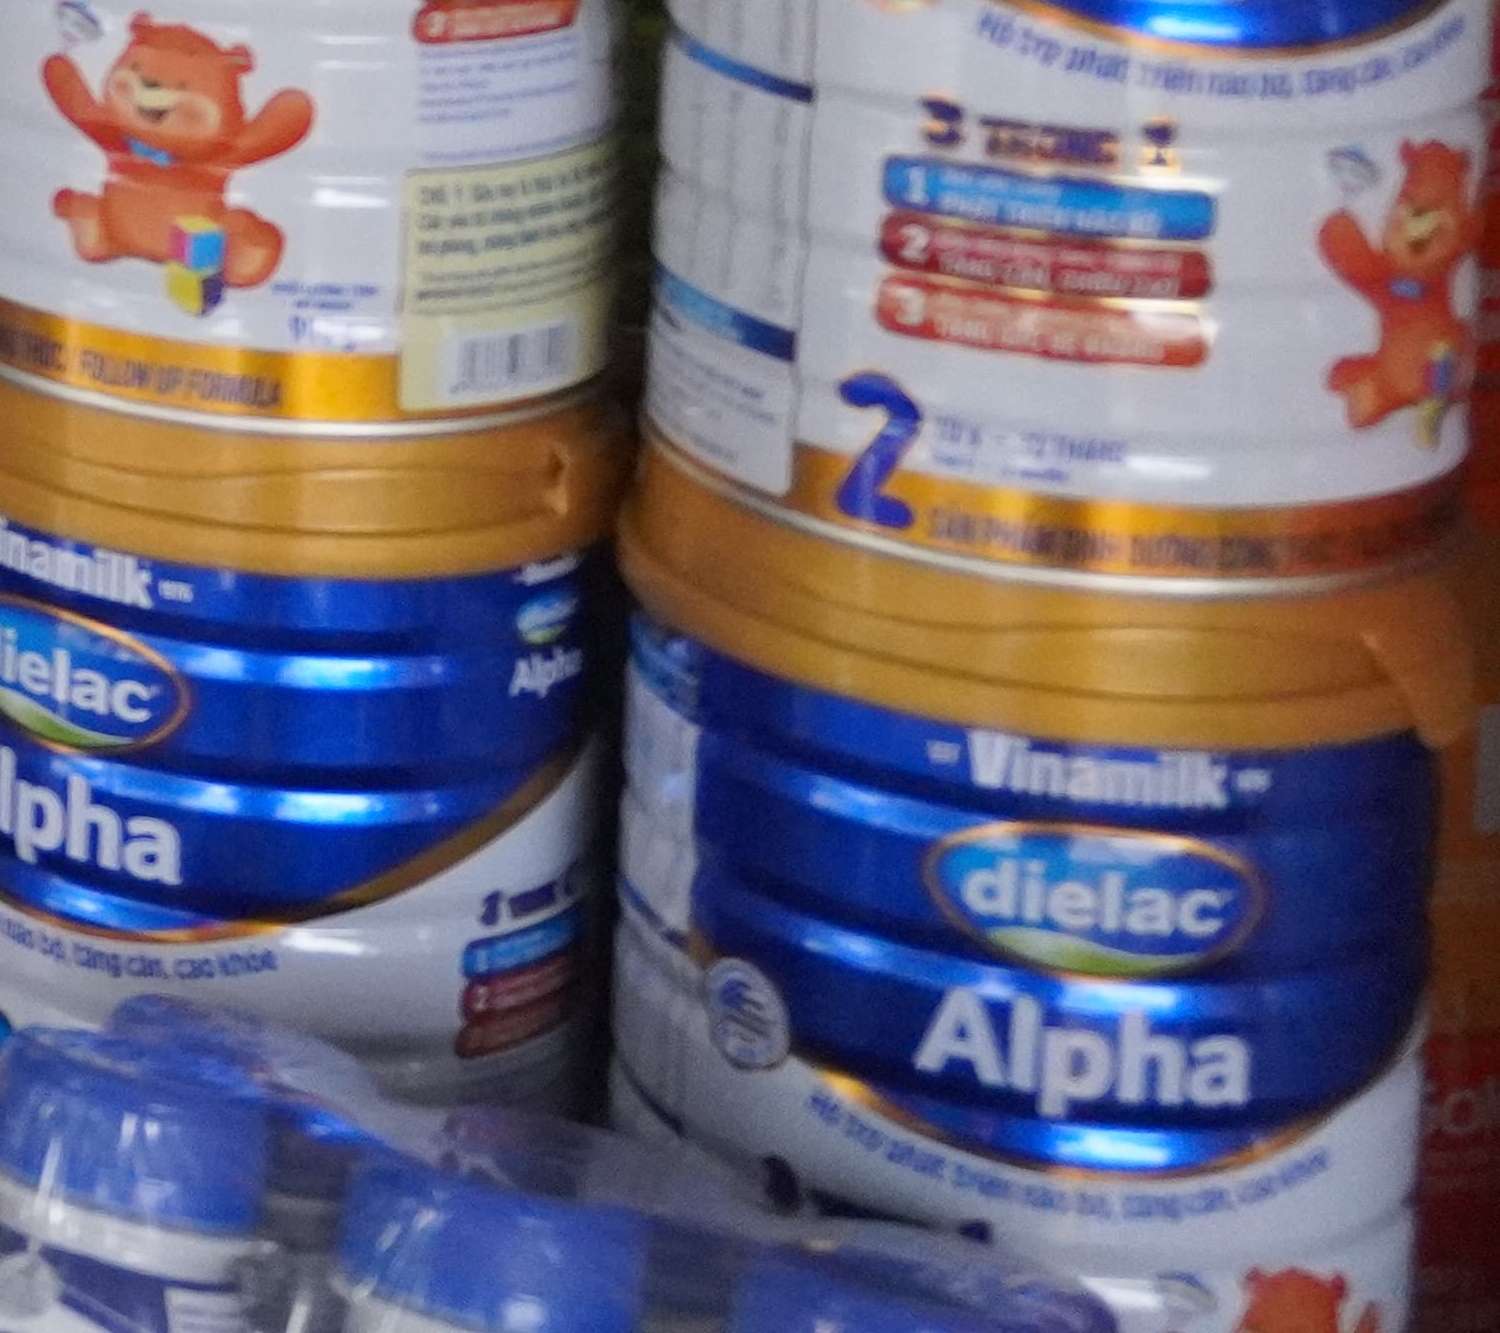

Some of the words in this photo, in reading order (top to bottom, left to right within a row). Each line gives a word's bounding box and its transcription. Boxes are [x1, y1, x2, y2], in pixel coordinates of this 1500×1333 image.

[835, 370, 923, 531] 2
[966, 731, 1232, 810] Vinamilk
[959, 859, 1225, 937] dielac
[913, 986, 1254, 1121] Alpha
